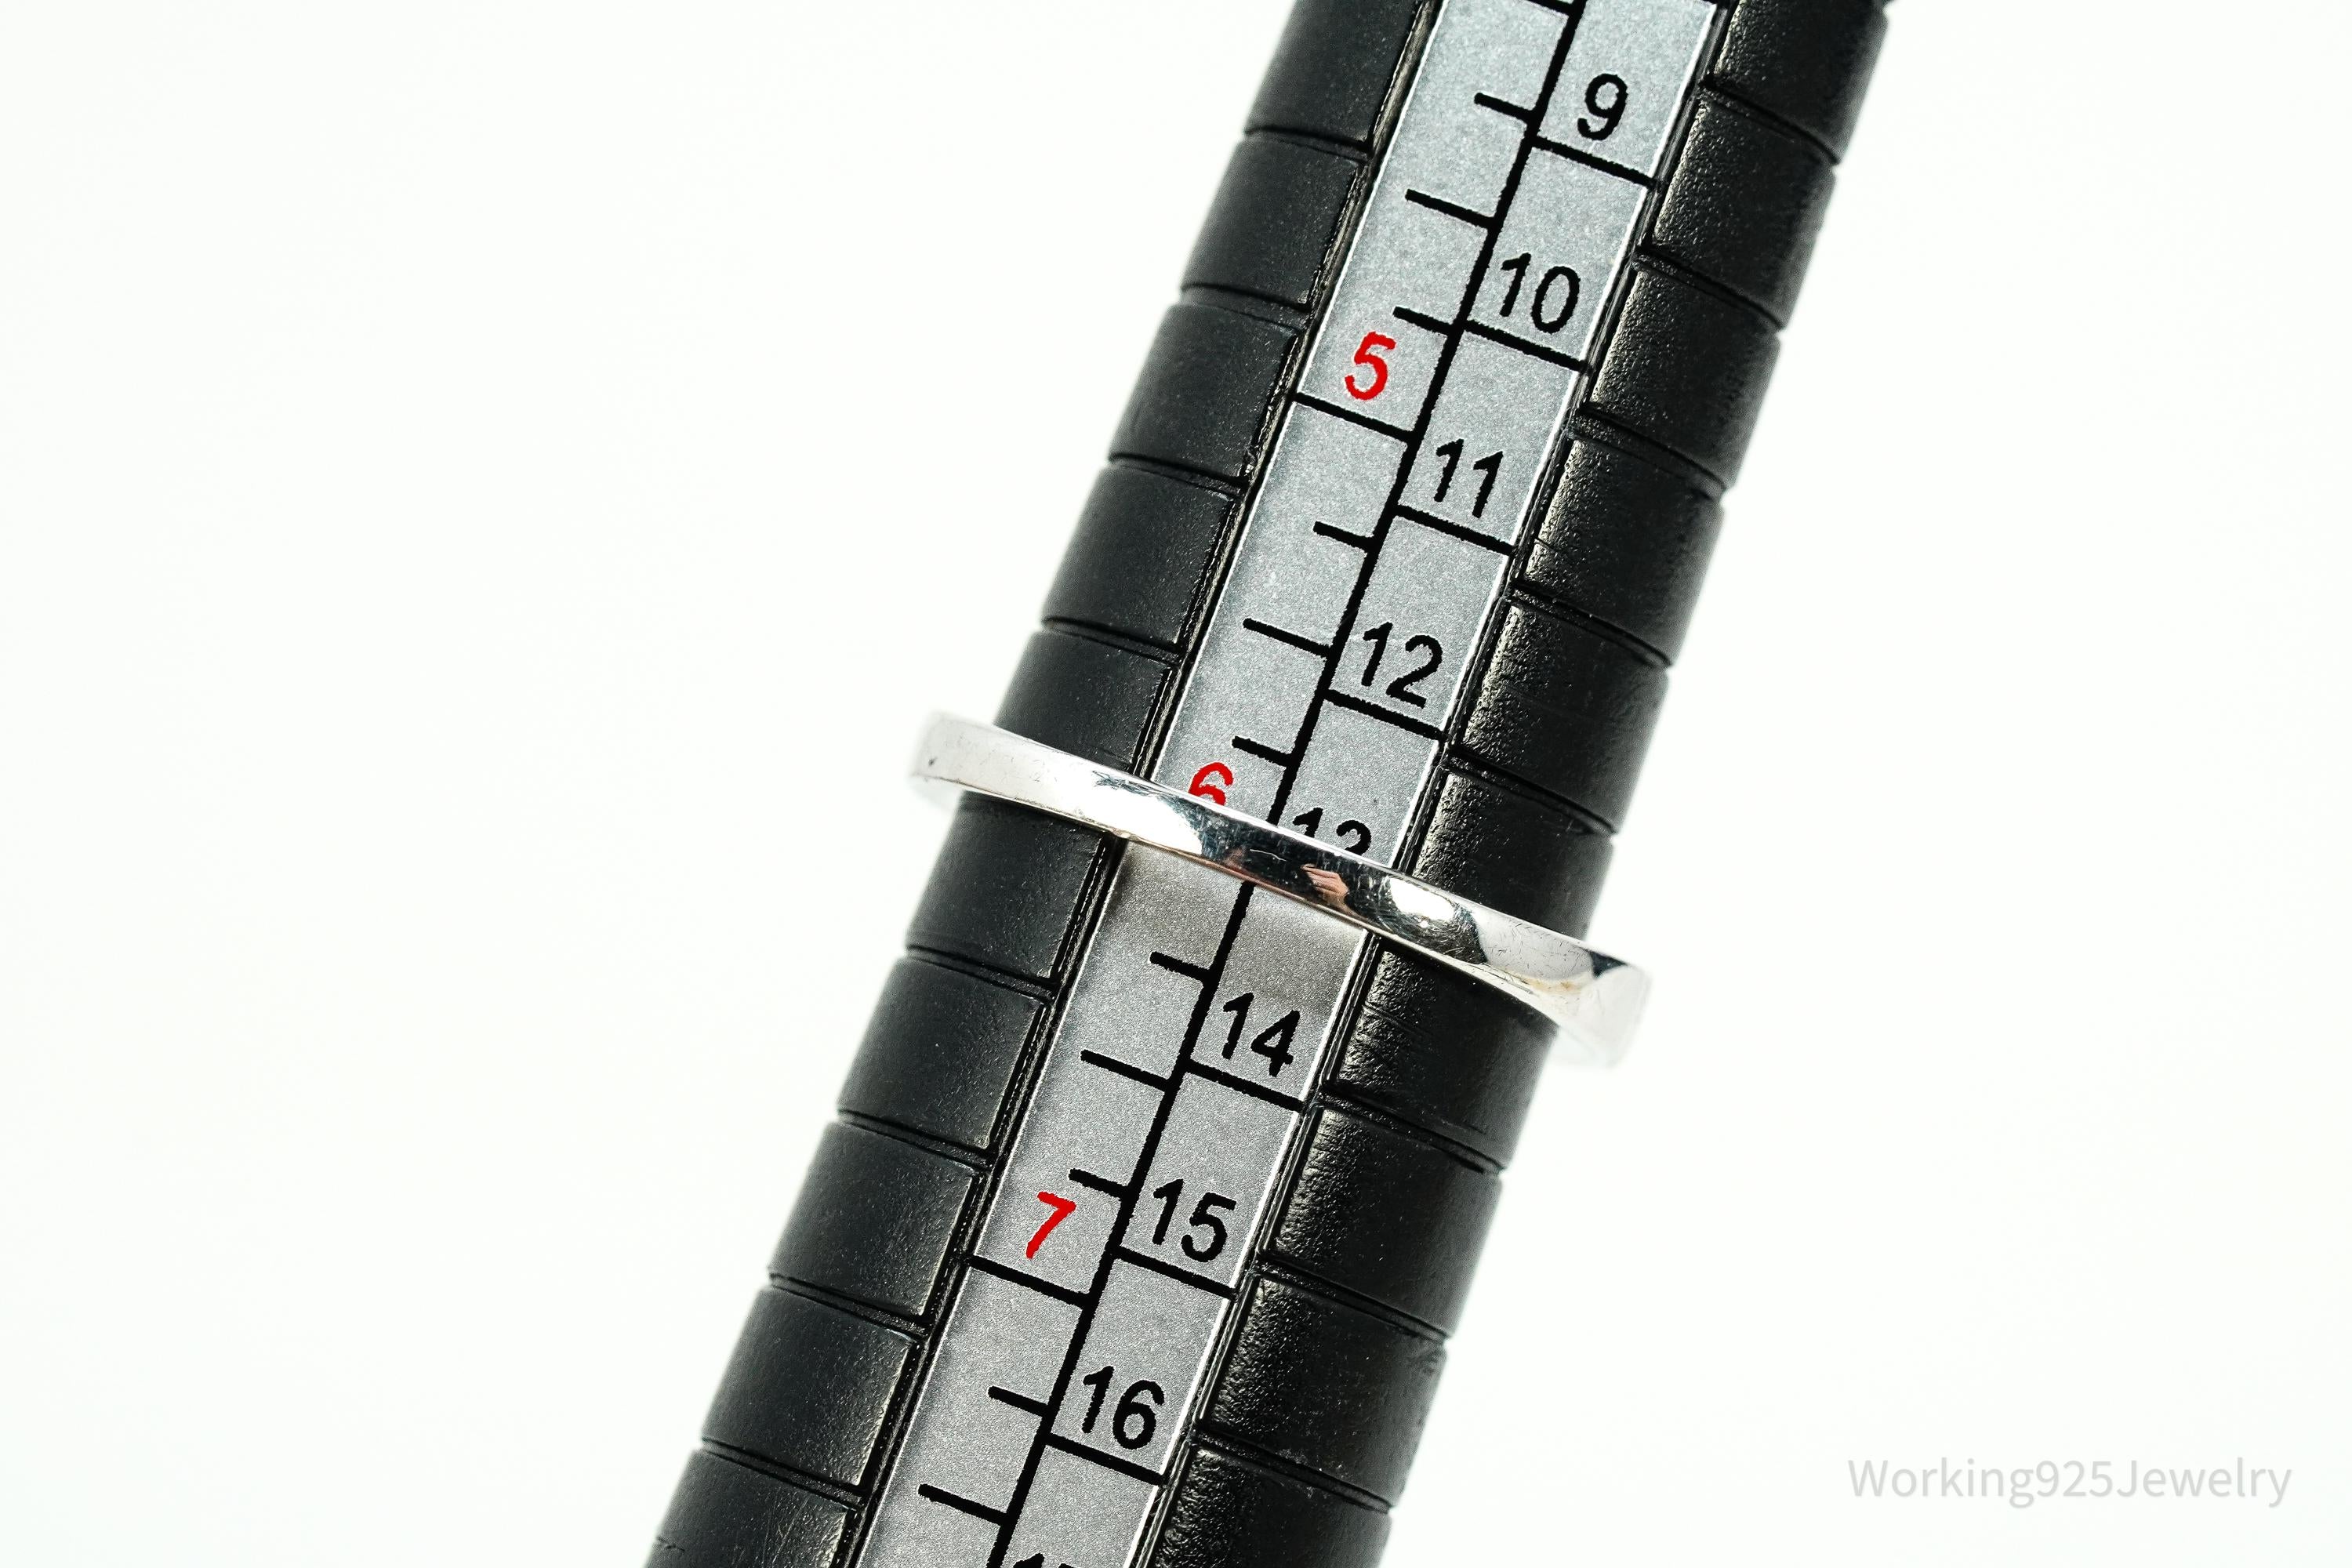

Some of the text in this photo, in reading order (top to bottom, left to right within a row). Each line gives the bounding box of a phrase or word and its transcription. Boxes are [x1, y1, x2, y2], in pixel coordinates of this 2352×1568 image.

[1577, 74, 1629, 141] 9
[1500, 252, 1581, 336] 10
[1345, 331, 1396, 401] 5
[1434, 438, 1504, 520] 11
[1361, 621, 1443, 710] 12
[1221, 992, 1301, 1078] 14
[1025, 1191, 1076, 1259] 7
[1152, 1178, 1237, 1263] 15
[1082, 1365, 1165, 1451] 16
